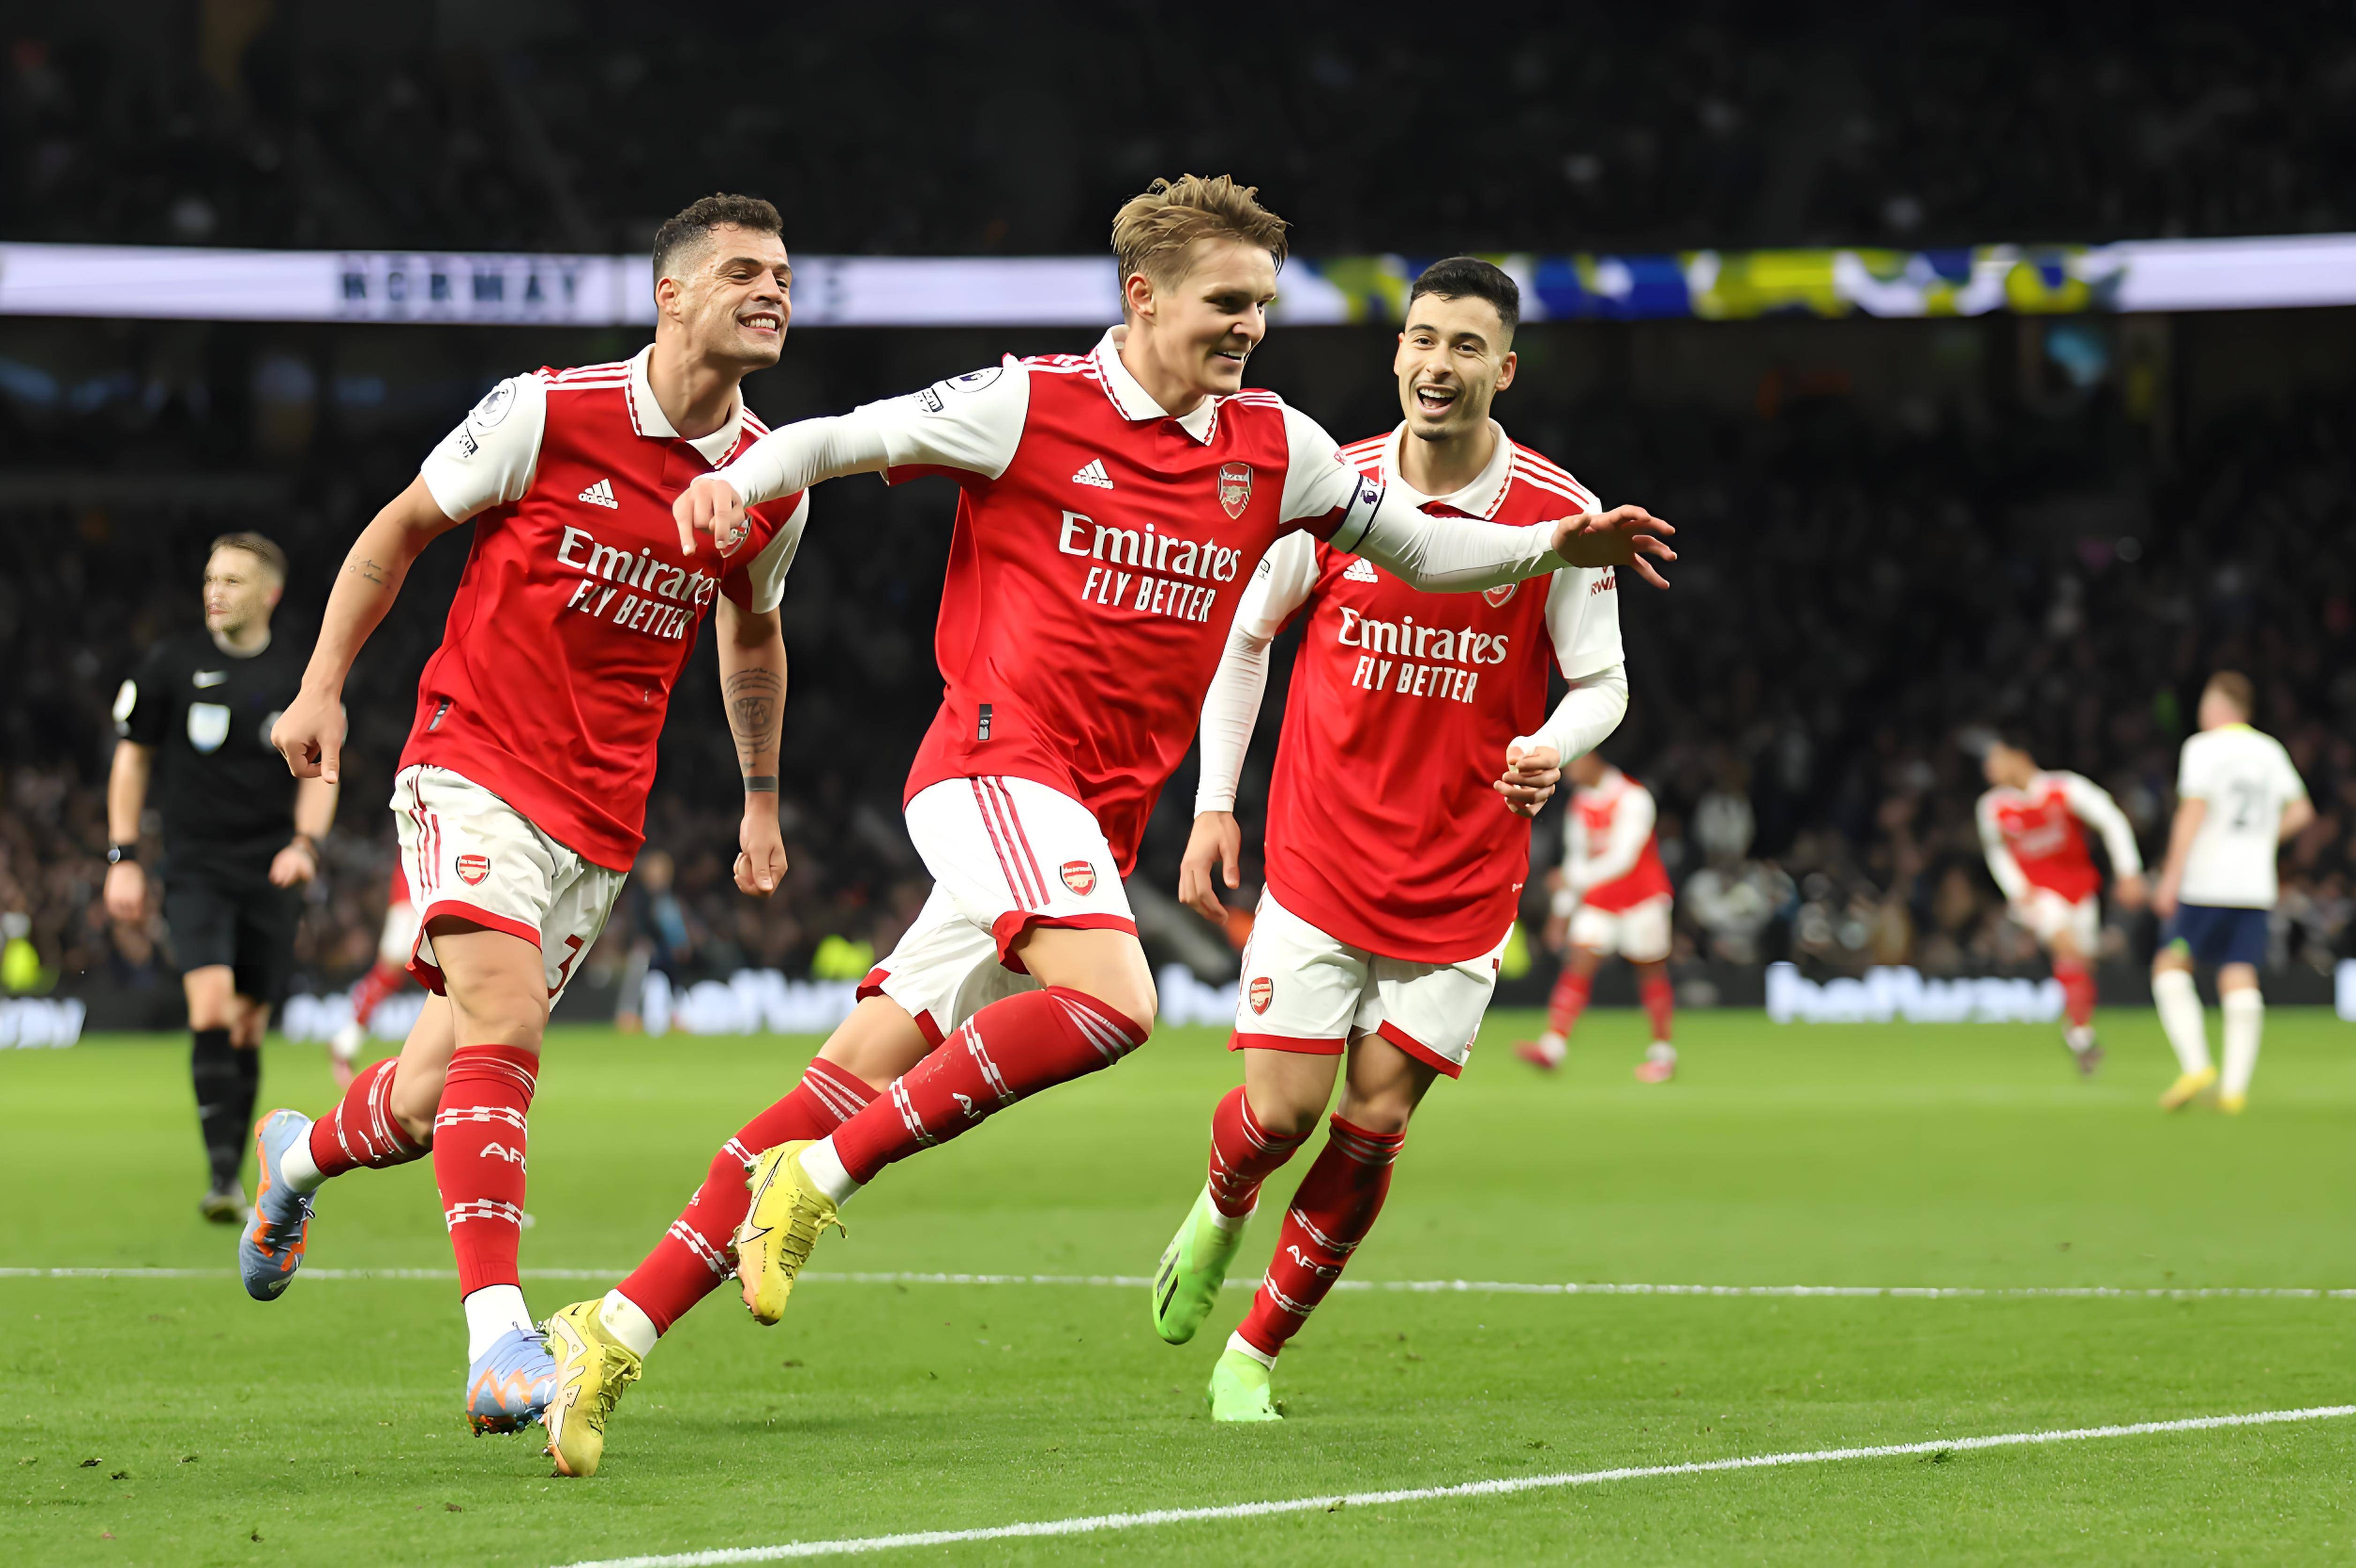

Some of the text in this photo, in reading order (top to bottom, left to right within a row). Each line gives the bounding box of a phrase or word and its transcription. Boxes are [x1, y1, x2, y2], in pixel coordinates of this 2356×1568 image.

[1058, 510, 1242, 582] Emirates
[567, 579, 695, 640] FLY BETTER
[1081, 566, 1216, 623] FLY BETTER
[1338, 606, 1509, 664] Emirates
[1352, 655, 1478, 704] FLY BETTER
